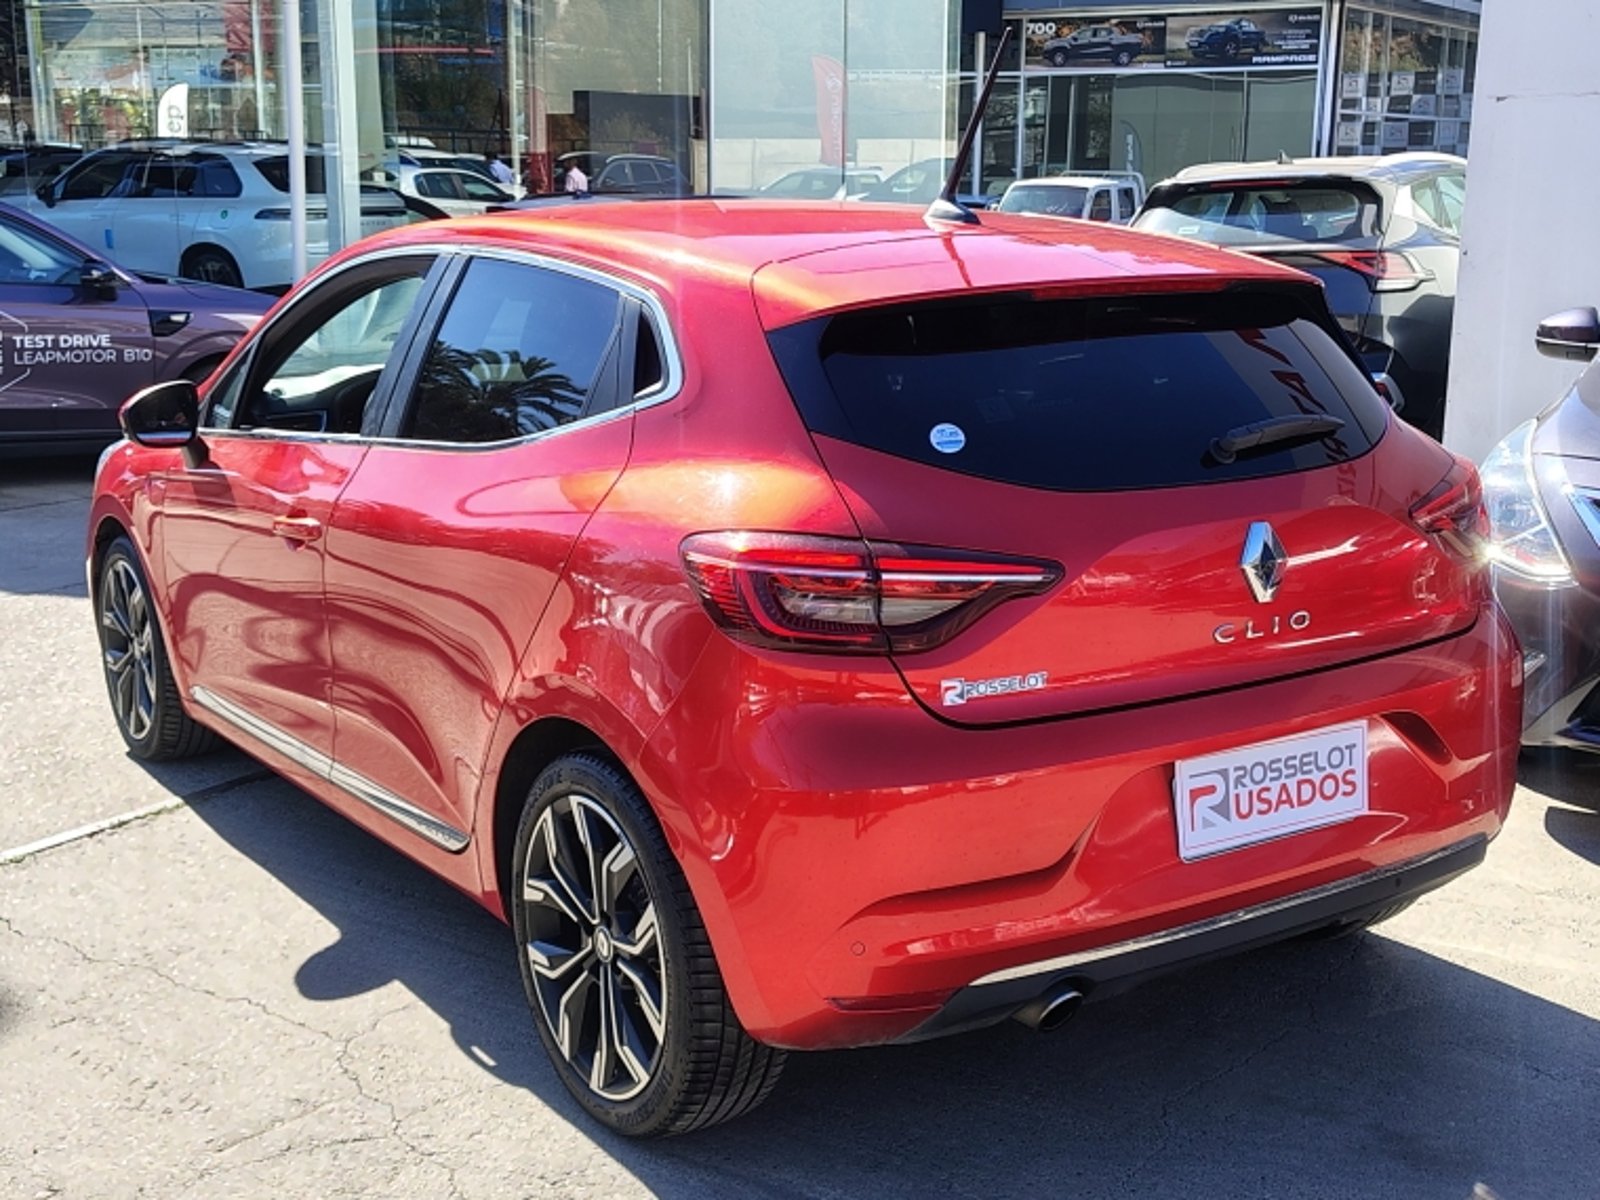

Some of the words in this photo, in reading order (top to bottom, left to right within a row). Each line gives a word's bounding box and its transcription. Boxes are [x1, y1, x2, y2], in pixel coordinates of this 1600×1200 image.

[1027, 22, 1056, 35] 700
[1252, 54, 1317, 64] RAMPAGE
[167, 104, 184, 133] ep
[12, 335, 55, 348] TEST
[59, 334, 112, 348] DRIVE
[14, 350, 117, 365] LEAPMOTOR
[123, 349, 152, 363] B10
[1214, 610, 1311, 643] CLIO
[965, 671, 1047, 698] ROSSELOT
[1233, 744, 1357, 790] ROSSELOT
[1235, 768, 1357, 820] USADOS
